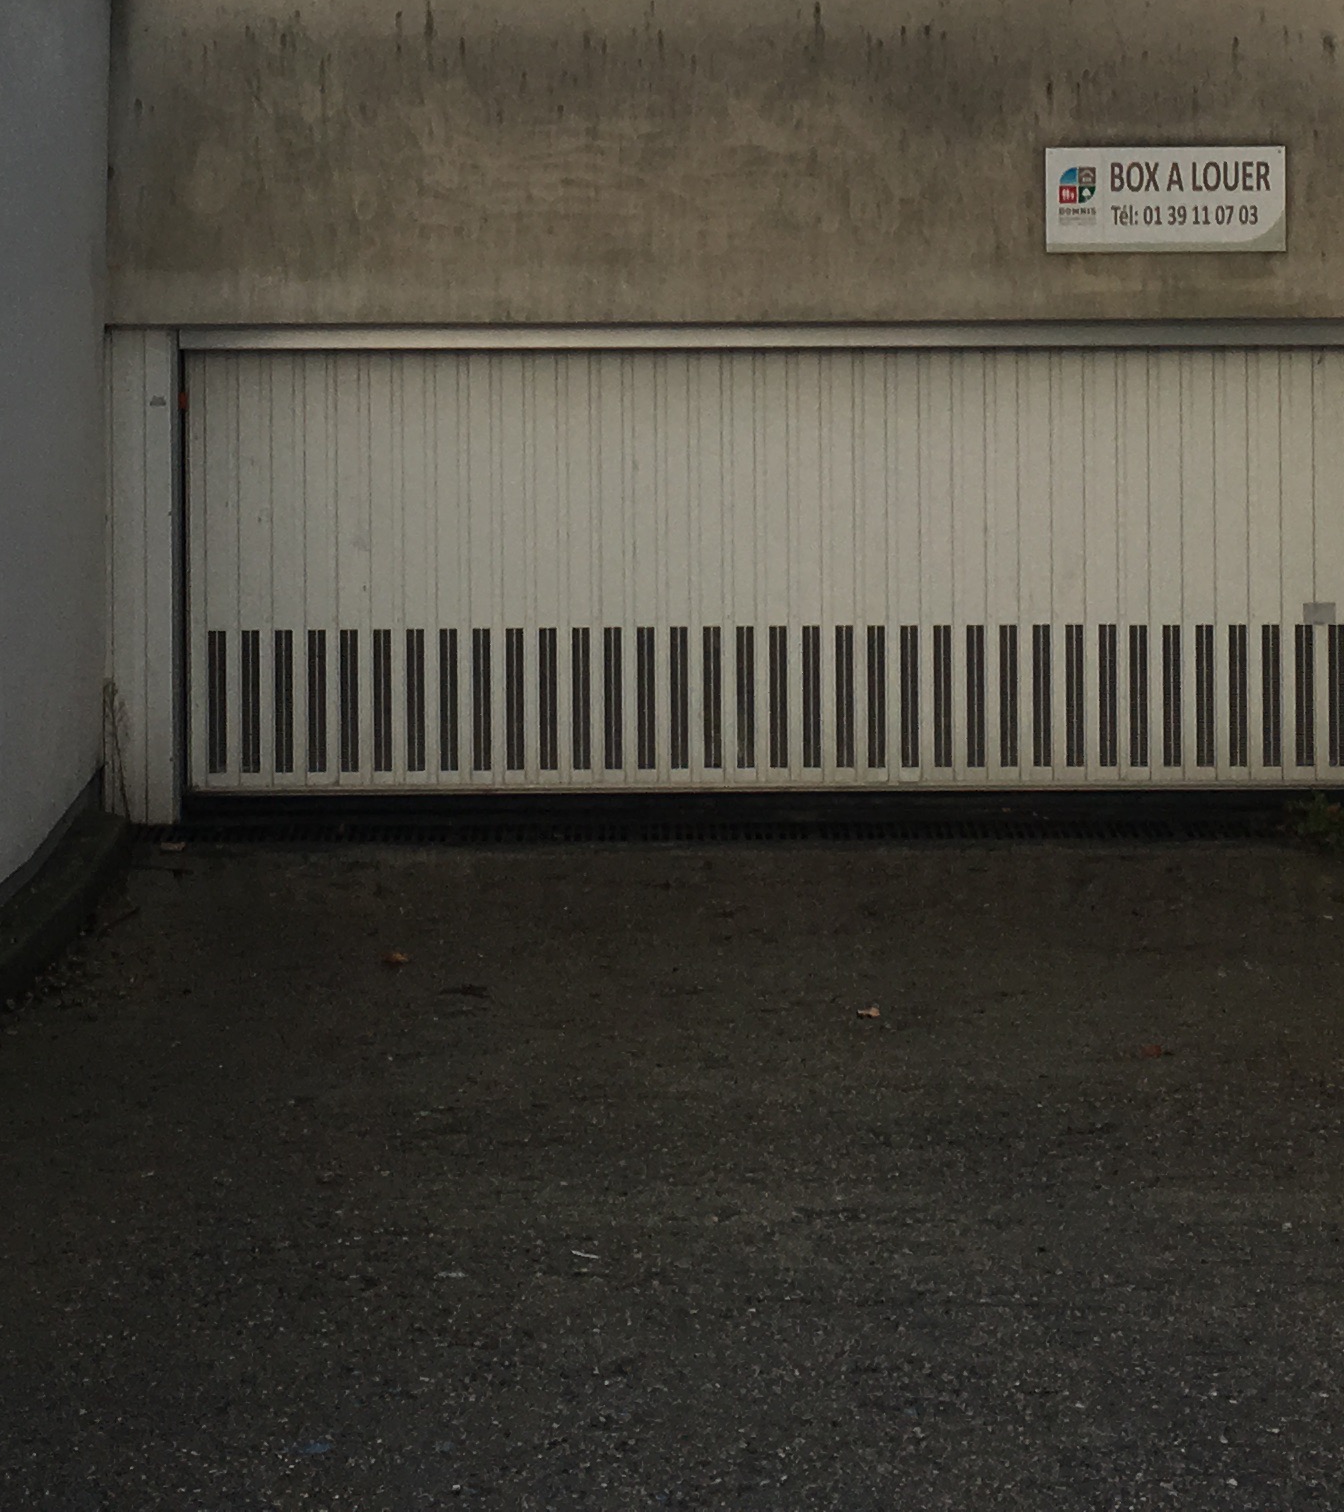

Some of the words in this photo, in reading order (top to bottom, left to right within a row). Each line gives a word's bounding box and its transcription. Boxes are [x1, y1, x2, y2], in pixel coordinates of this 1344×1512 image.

[1110, 161, 1160, 192] BOX
[1166, 161, 1184, 192] A
[1191, 160, 1271, 192] LOUER
[1110, 204, 1139, 226] Tél:
[1143, 205, 1163, 225] 01
[1167, 205, 1187, 225] 39
[1191, 204, 1211, 225] 11
[1215, 204, 1234, 225] 07
[1238, 204, 1259, 225] 03
